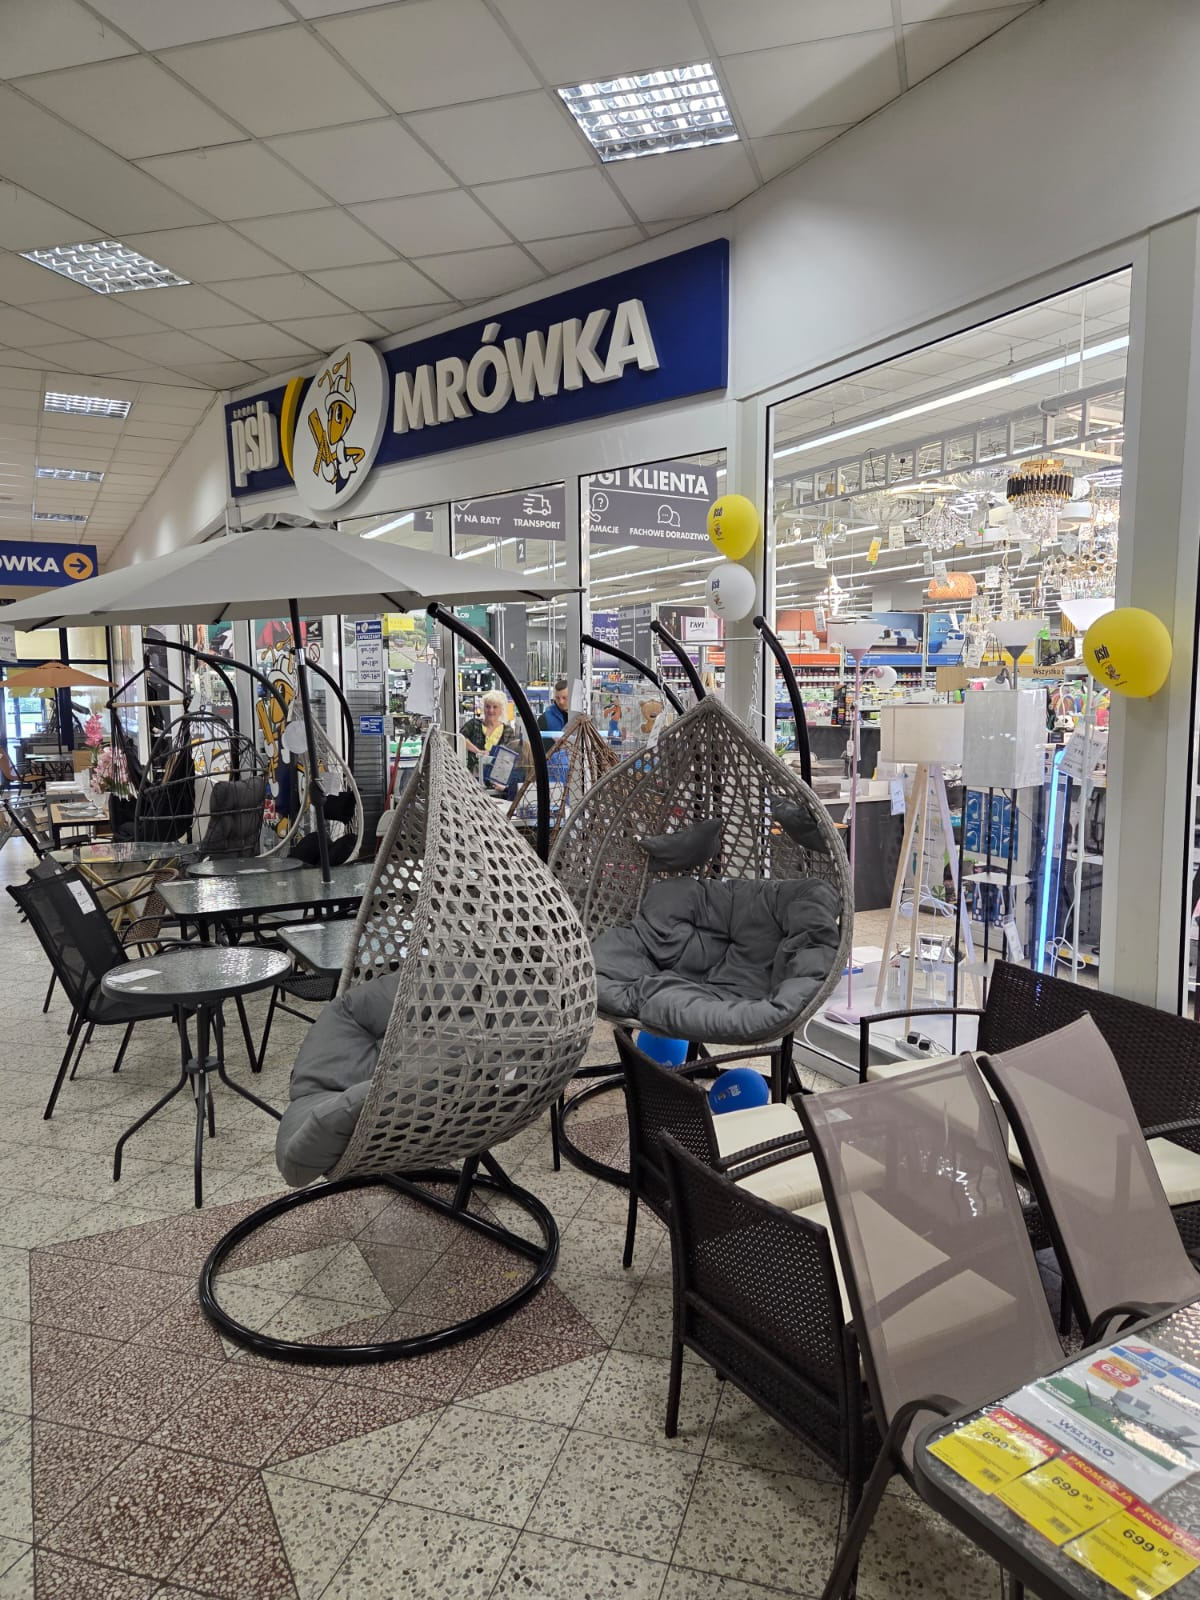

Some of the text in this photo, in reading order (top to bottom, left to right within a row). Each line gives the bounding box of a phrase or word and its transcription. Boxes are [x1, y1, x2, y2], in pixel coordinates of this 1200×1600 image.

[393, 298, 660, 434] MRÓWKA
[231, 400, 280, 487] psb
[628, 467, 709, 495] KLIENTA
[464, 514, 478, 523] NA
[480, 515, 502, 525] RATY
[513, 518, 561, 530] TRANSPORT
[629, 527, 710, 541] FACHOWE DORADZTWO
[518, 544, 525, 560] 2
[1101, 1363, 1131, 1382] 639
[1051, 1476, 1080, 1497] 699
[1068, 1455, 1133, 1504] PROMOCJA
[1122, 1529, 1155, 1552] 699
